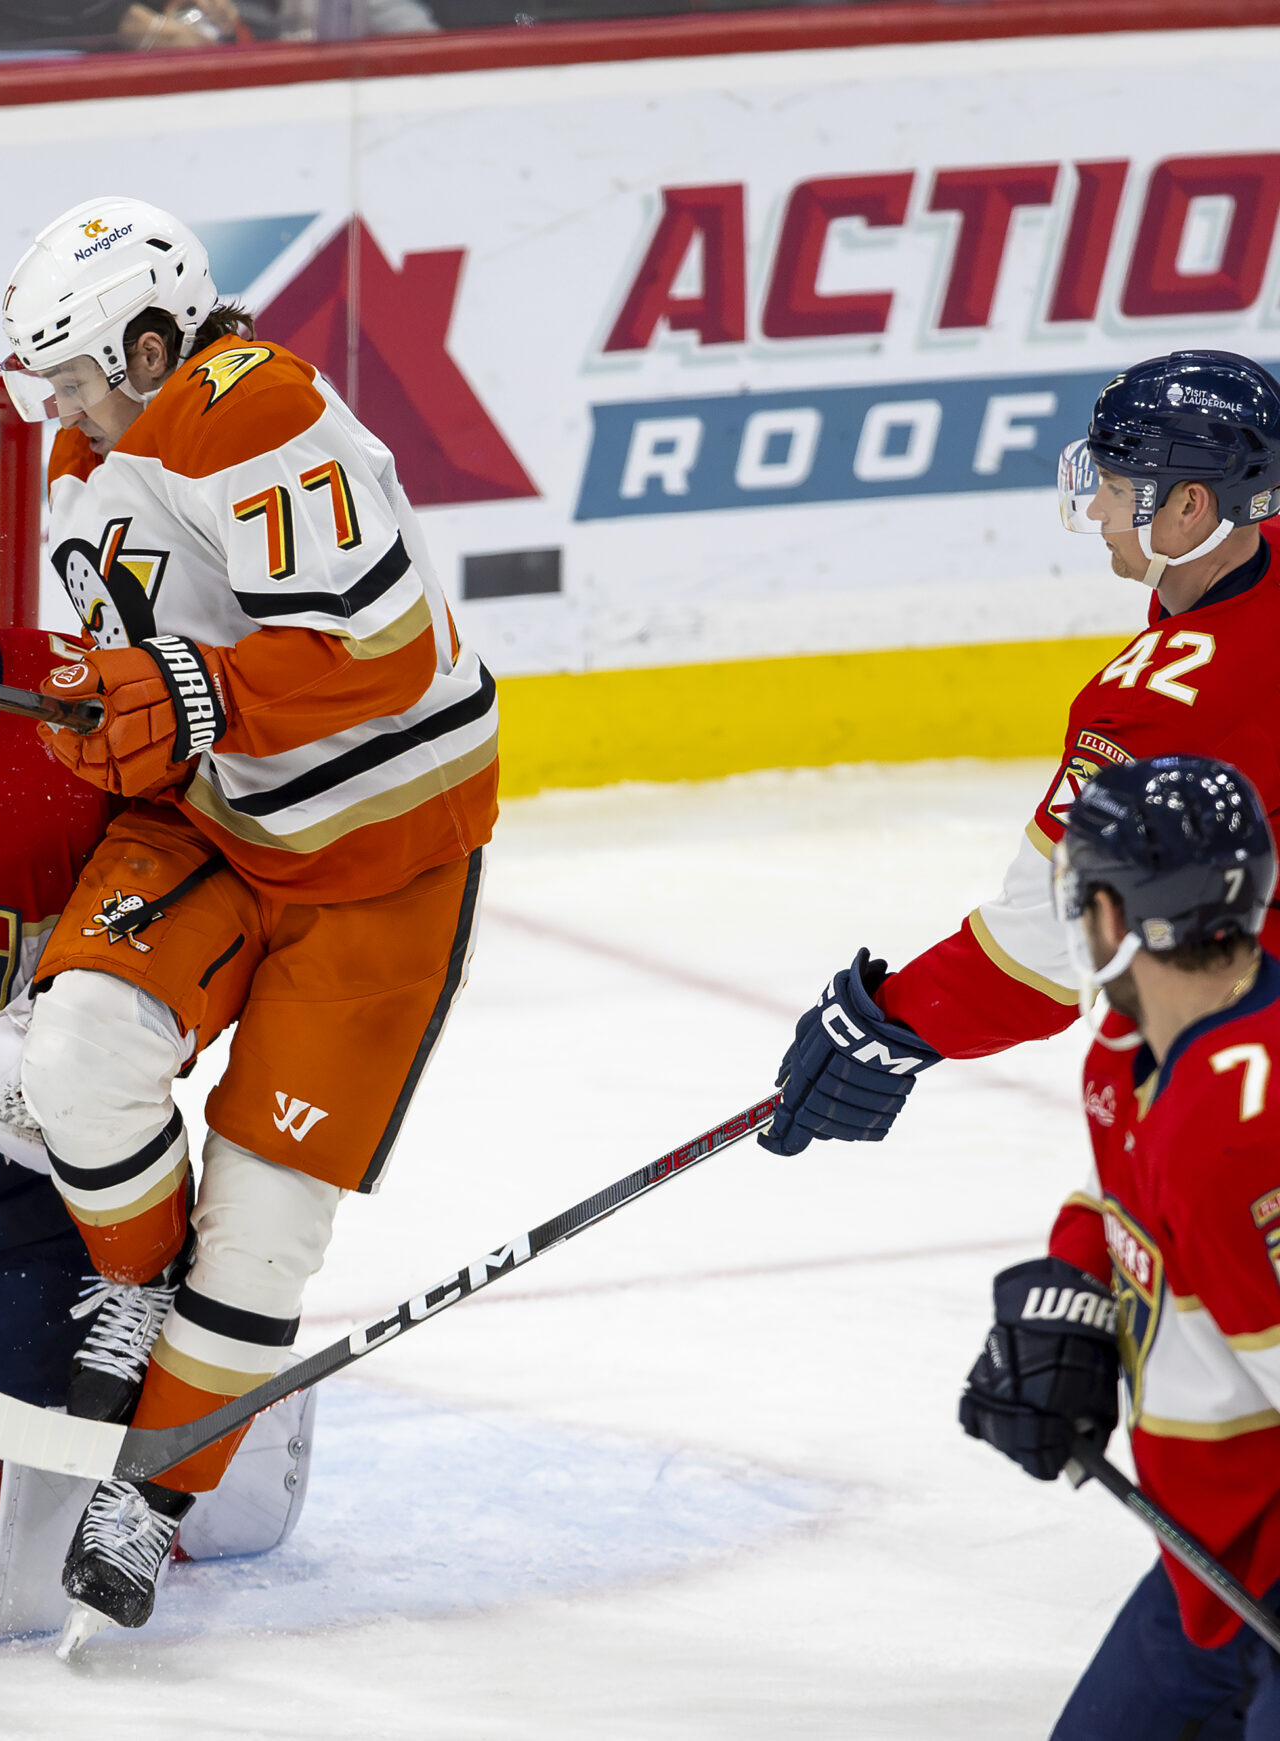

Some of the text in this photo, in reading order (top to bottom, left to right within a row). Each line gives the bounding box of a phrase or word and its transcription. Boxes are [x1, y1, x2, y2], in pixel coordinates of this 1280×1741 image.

[74, 223, 133, 262] Navigator
[602, 152, 1280, 354] ACTIO
[1183, 395, 1243, 413] LAUDERDALE
[1185, 387, 1207, 398] VISIT
[231, 458, 363, 583] 77
[1098, 630, 1217, 707] 42
[1223, 867, 1245, 905] 7
[1208, 1042, 1272, 1124] 7
[649, 1092, 784, 1184] JETSP
[349, 1231, 532, 1357] CCM
